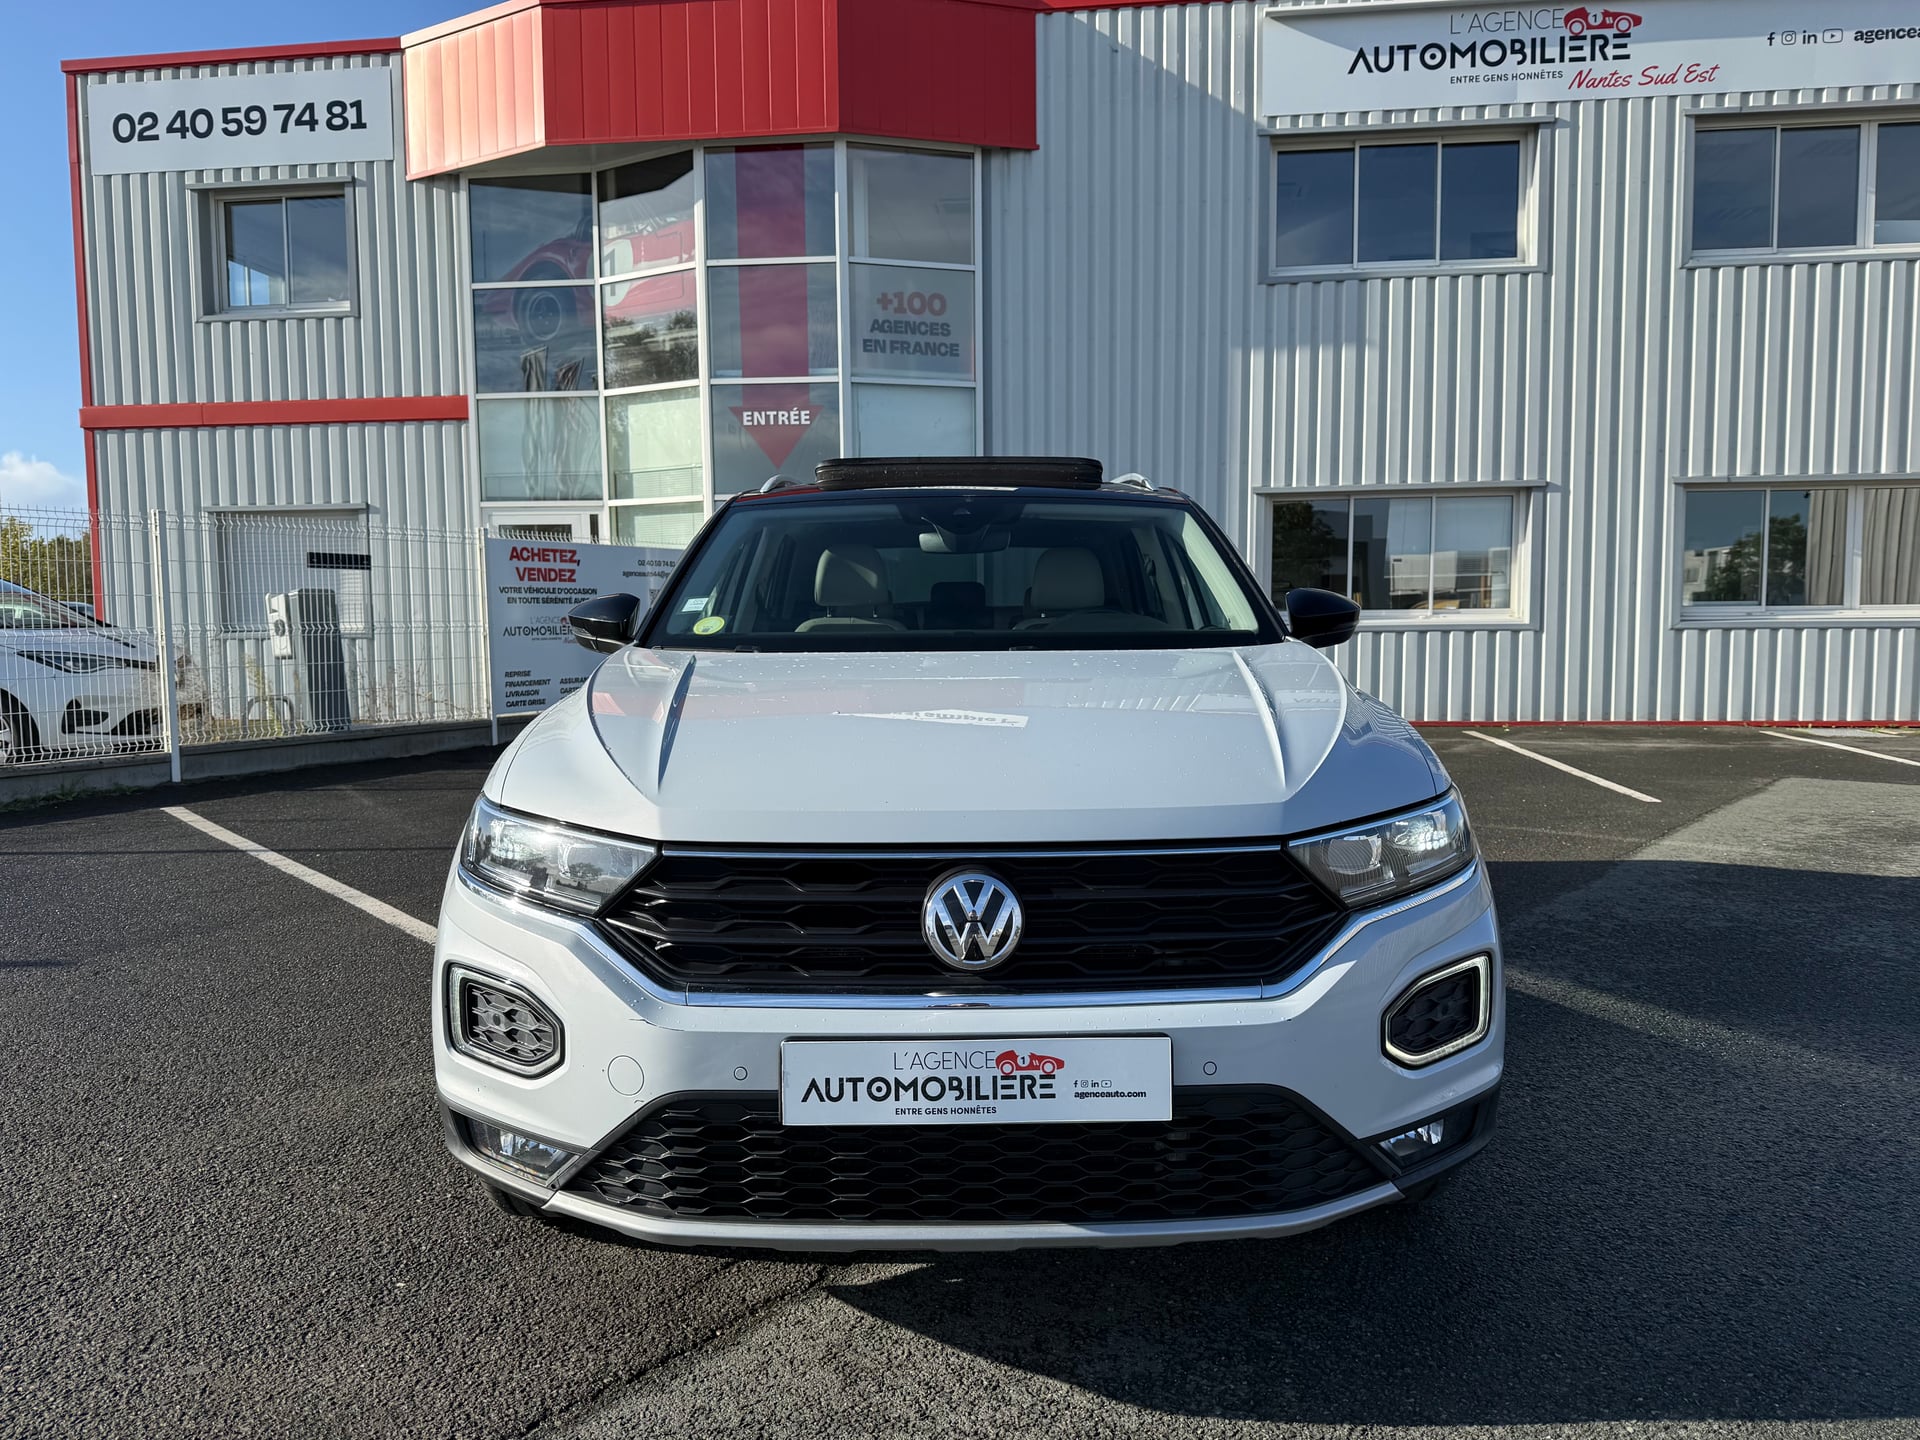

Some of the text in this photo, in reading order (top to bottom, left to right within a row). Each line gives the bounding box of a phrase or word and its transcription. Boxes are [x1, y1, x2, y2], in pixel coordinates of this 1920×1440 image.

[1450, 8, 1565, 35] L'AGENCE
[1450, 69, 1563, 84] ENTRE GENS HONNÊTES
[1568, 63, 1721, 90] Nantes Sud Est
[112, 99, 367, 143] 02 40 59 74 81
[876, 291, 947, 317] +100
[870, 319, 951, 337] AGENCES
[862, 338, 960, 357] EN FRANCE
[742, 407, 810, 426] ENTRÉE
[509, 546, 581, 566] ACHETEZ,
[515, 567, 576, 582] VENDEZ
[499, 585, 597, 595] VOTRE VÉHICULE D'OCCASION
[541, 595, 572, 604] SÉRÉNITÉ
[505, 670, 531, 678] REPRISE
[505, 679, 551, 688] FINANCEMENT
[505, 689, 540, 698] LIVRAISON
[506, 698, 546, 708] CARTE GRISE
[894, 1050, 996, 1070] L'AGENCE
[1074, 1090, 1146, 1099] agenceauto.com
[895, 1104, 997, 1115] ENTRE GENS HONNÊTES
